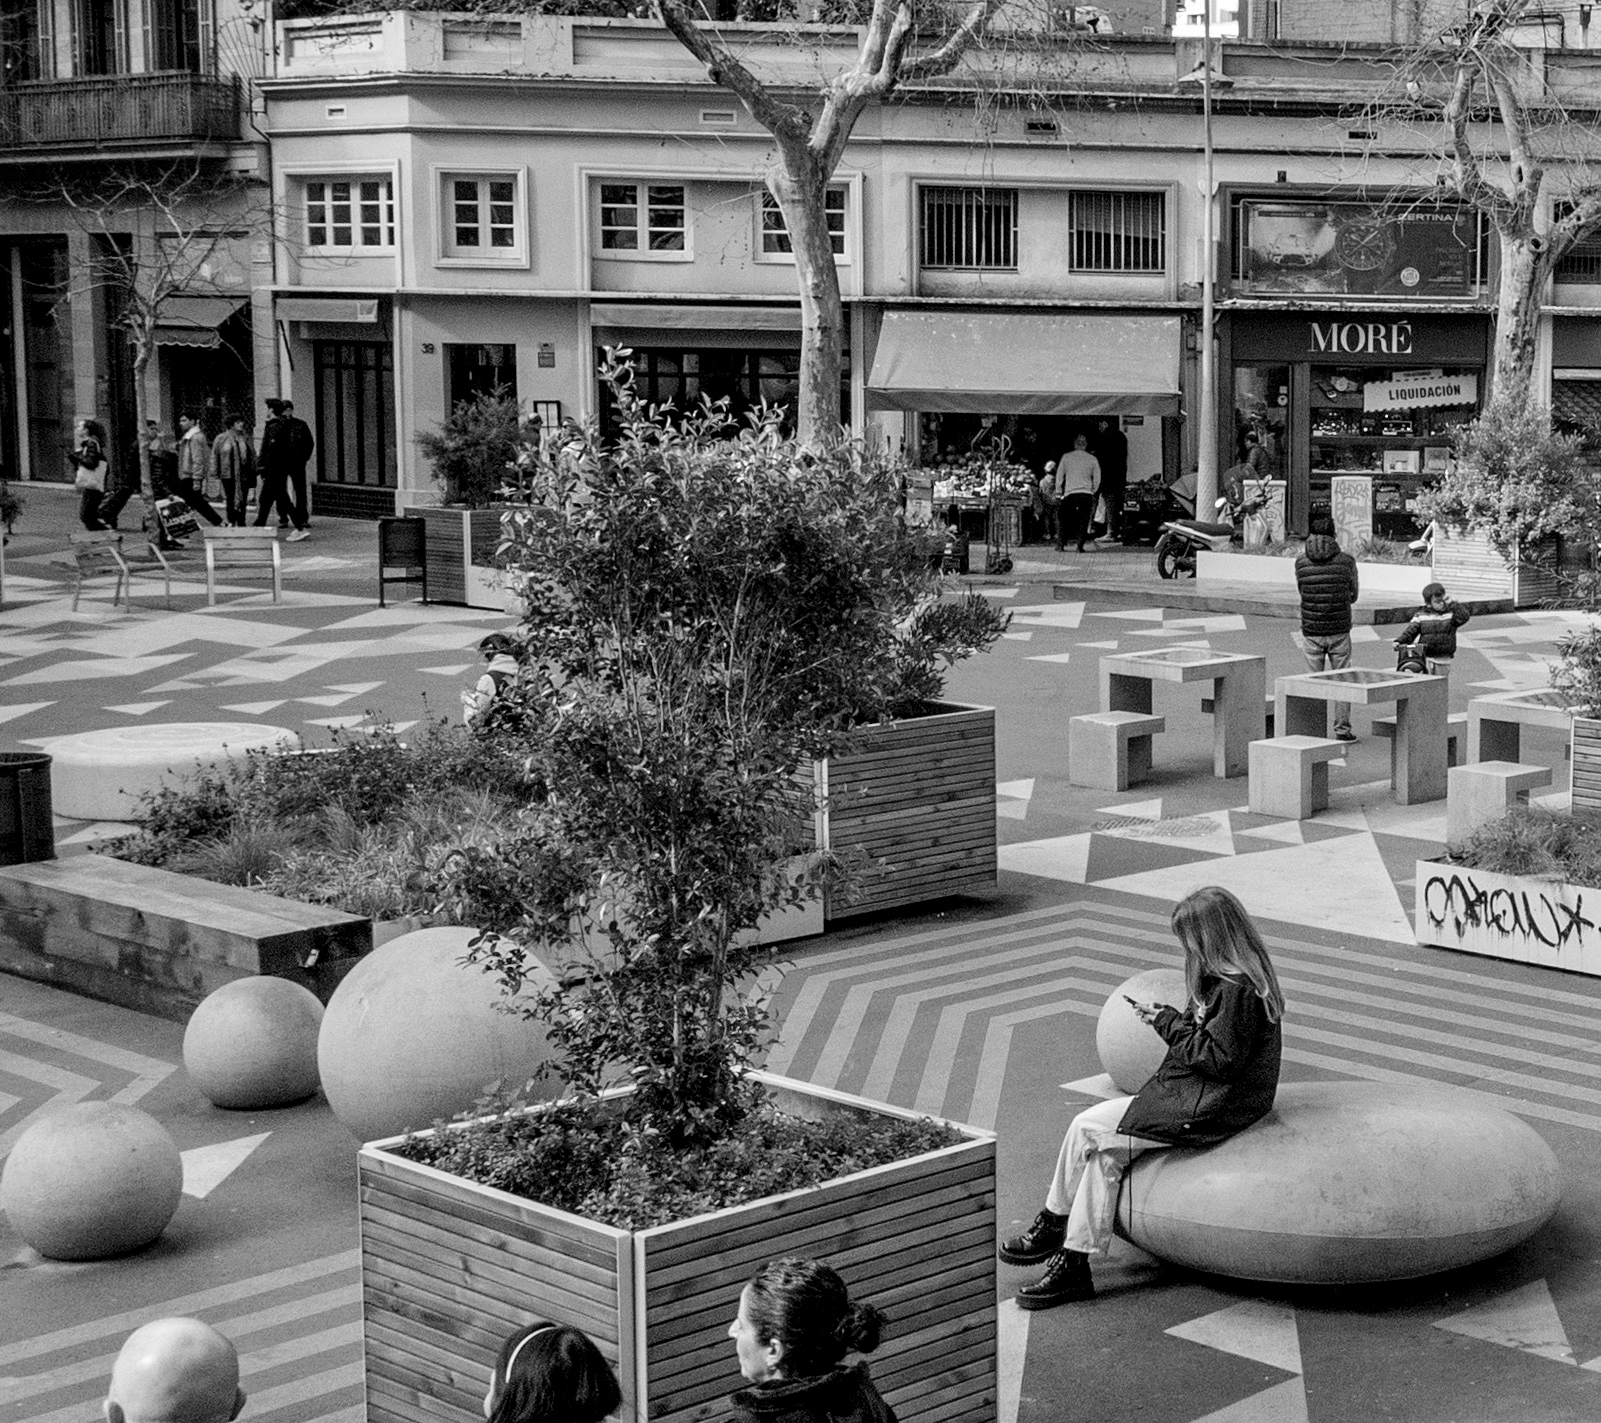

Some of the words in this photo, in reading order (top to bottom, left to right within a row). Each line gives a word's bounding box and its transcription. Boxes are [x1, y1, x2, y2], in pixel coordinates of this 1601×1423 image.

[1397, 213, 1454, 222] CERTINA
[1307, 319, 1413, 354] MORÉ
[421, 342, 435, 354] 39
[1388, 382, 1462, 401] LIQUIDACIÓN
